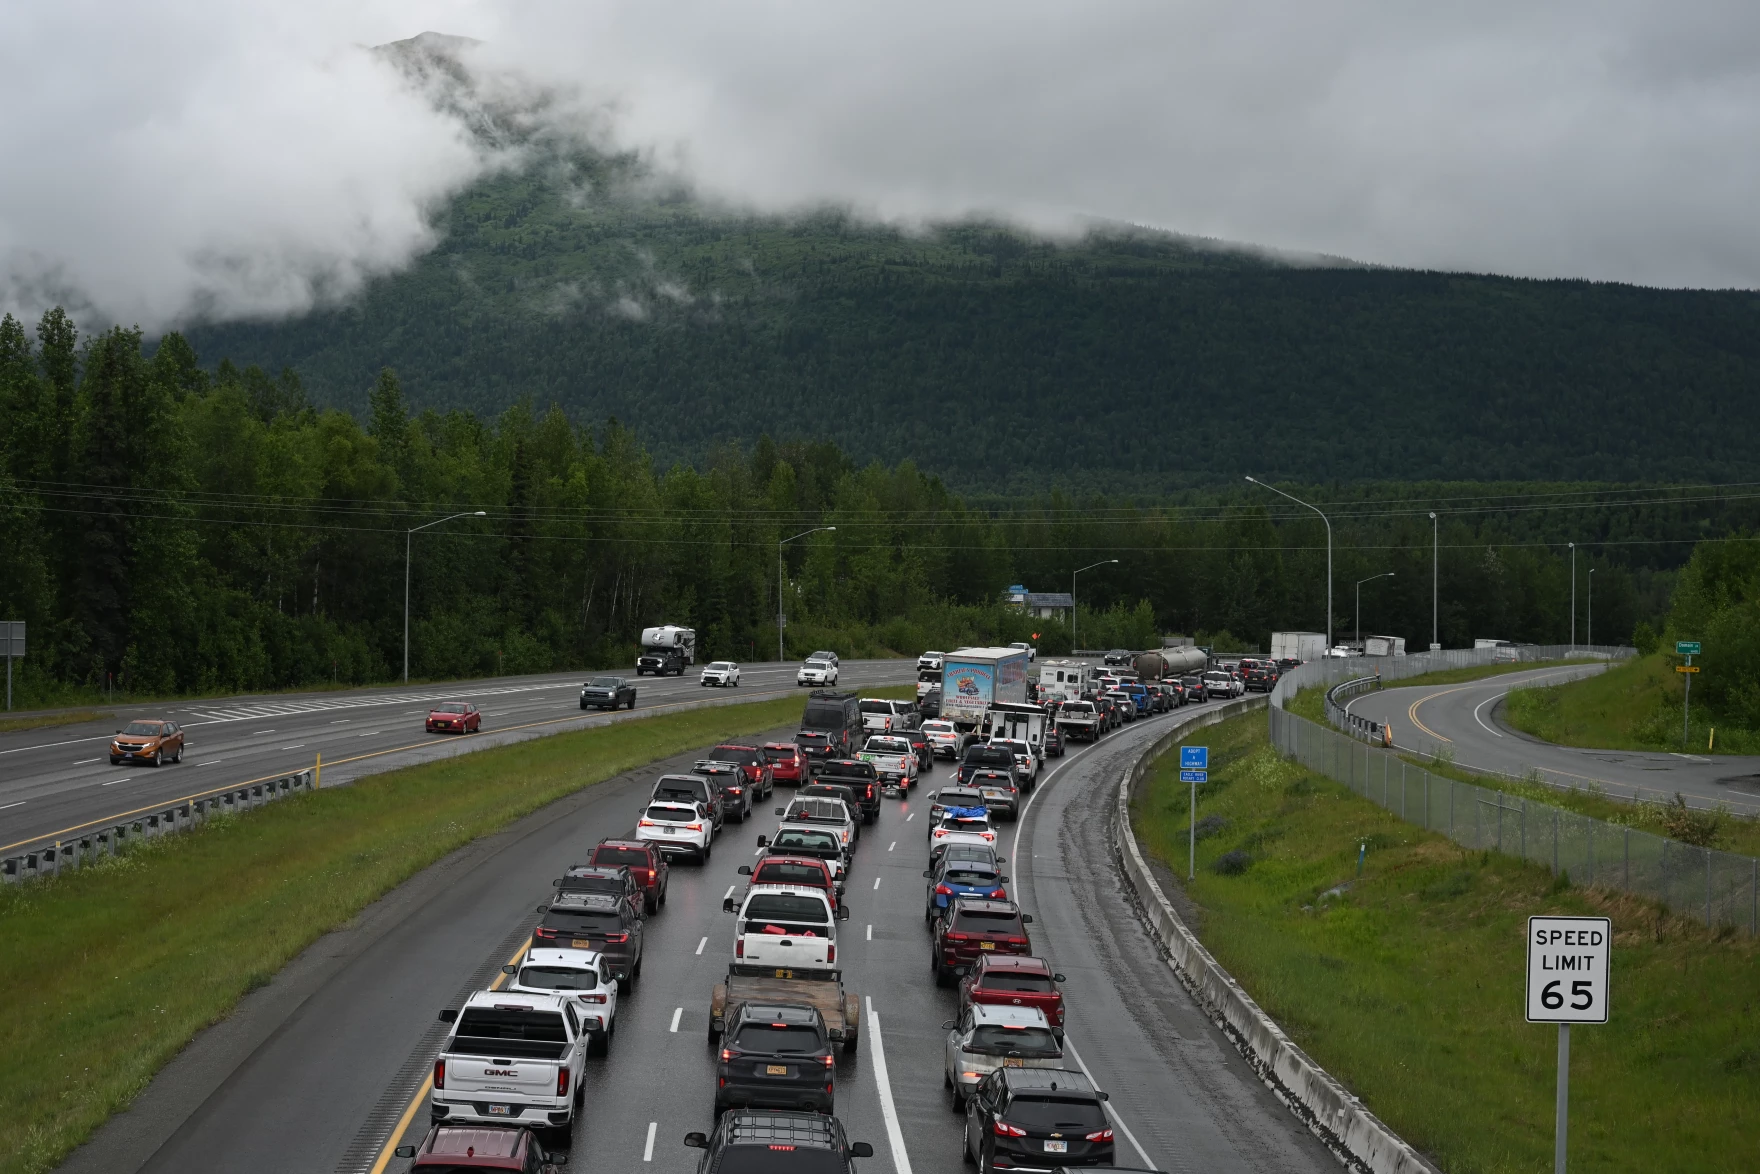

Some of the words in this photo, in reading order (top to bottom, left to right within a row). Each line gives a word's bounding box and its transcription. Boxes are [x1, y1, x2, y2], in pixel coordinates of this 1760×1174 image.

[1536, 930, 1602, 946] SPEED
[1543, 955, 1594, 970] LIMIT
[1541, 980, 1593, 1010] 65
